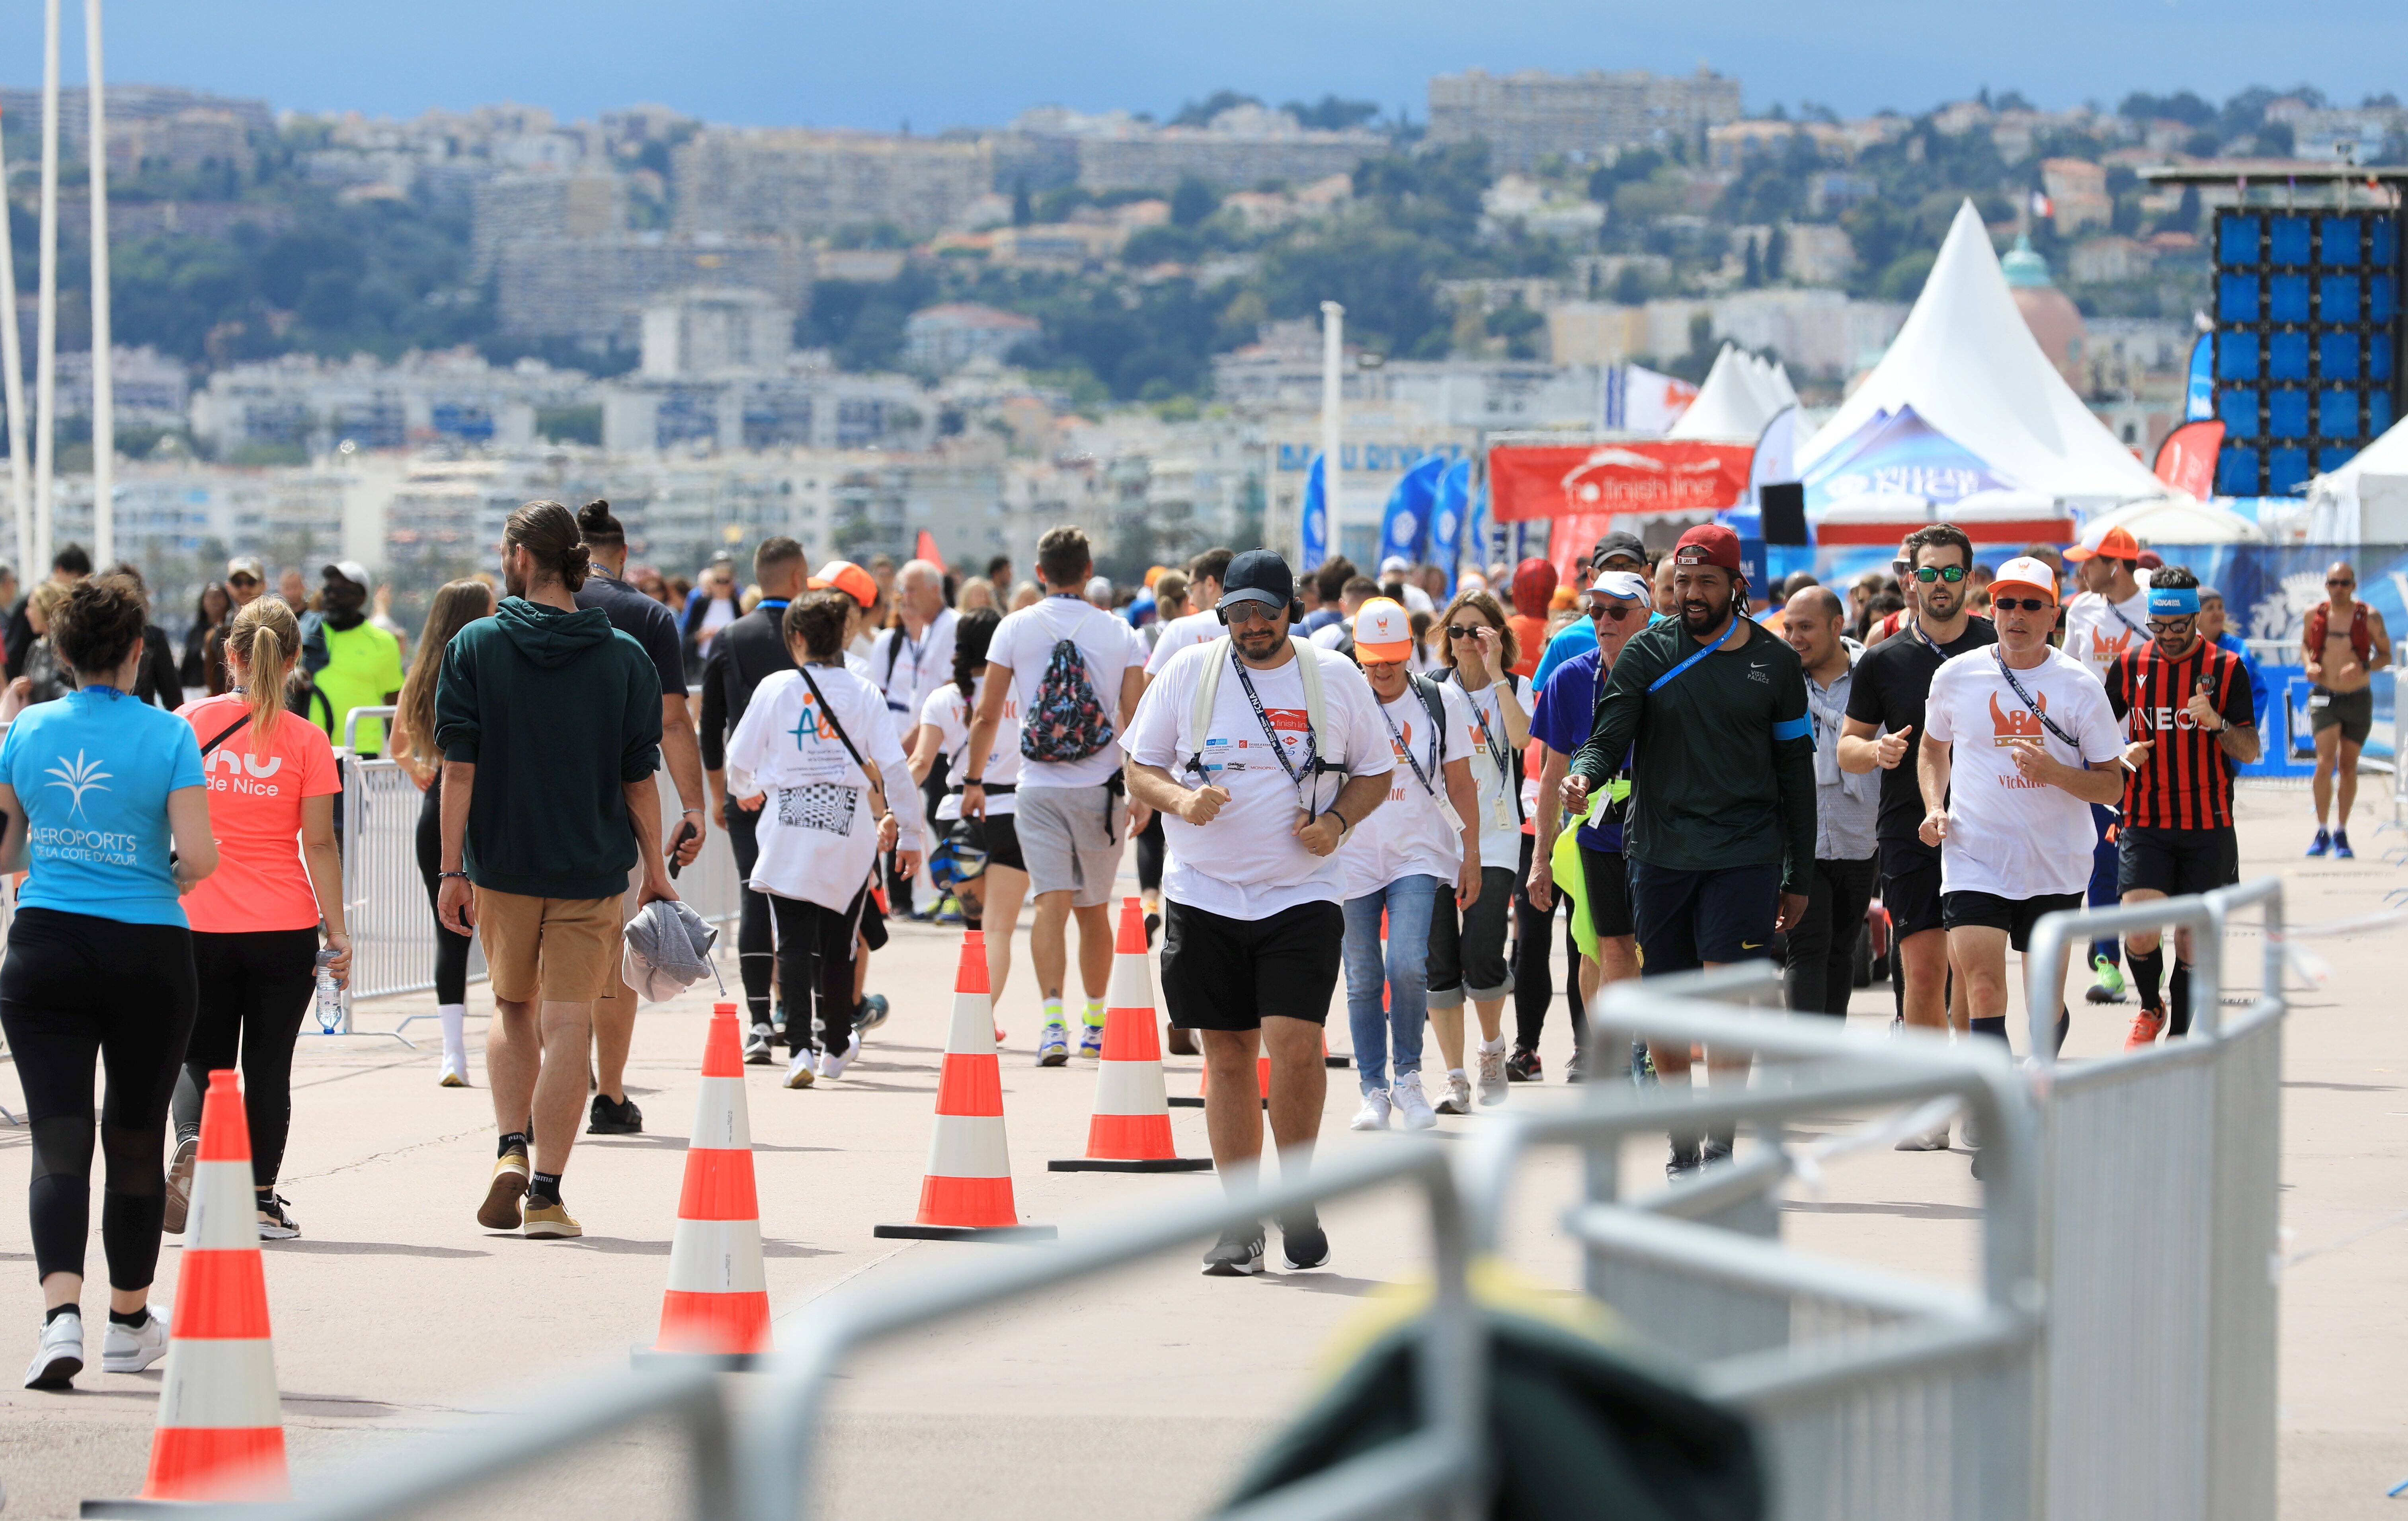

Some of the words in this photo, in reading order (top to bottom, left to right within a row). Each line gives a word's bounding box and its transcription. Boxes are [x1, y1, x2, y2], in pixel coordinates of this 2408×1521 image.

[1747, 674, 1770, 684] PALACE
[1751, 670, 1766, 678] VISTA
[1249, 692, 1264, 714] FCNA
[1419, 697, 1430, 713] FCNA
[2031, 705, 2046, 723] FCNA
[2131, 707, 2212, 732] INEO
[206, 775, 227, 791] de
[233, 777, 279, 797] Nice
[34, 828, 136, 852] AEROPORTS
[35, 845, 45, 856] DE
[46, 847, 57, 857] LA
[61, 847, 91, 861] COTE
[93, 851, 137, 866] D'AZUR
